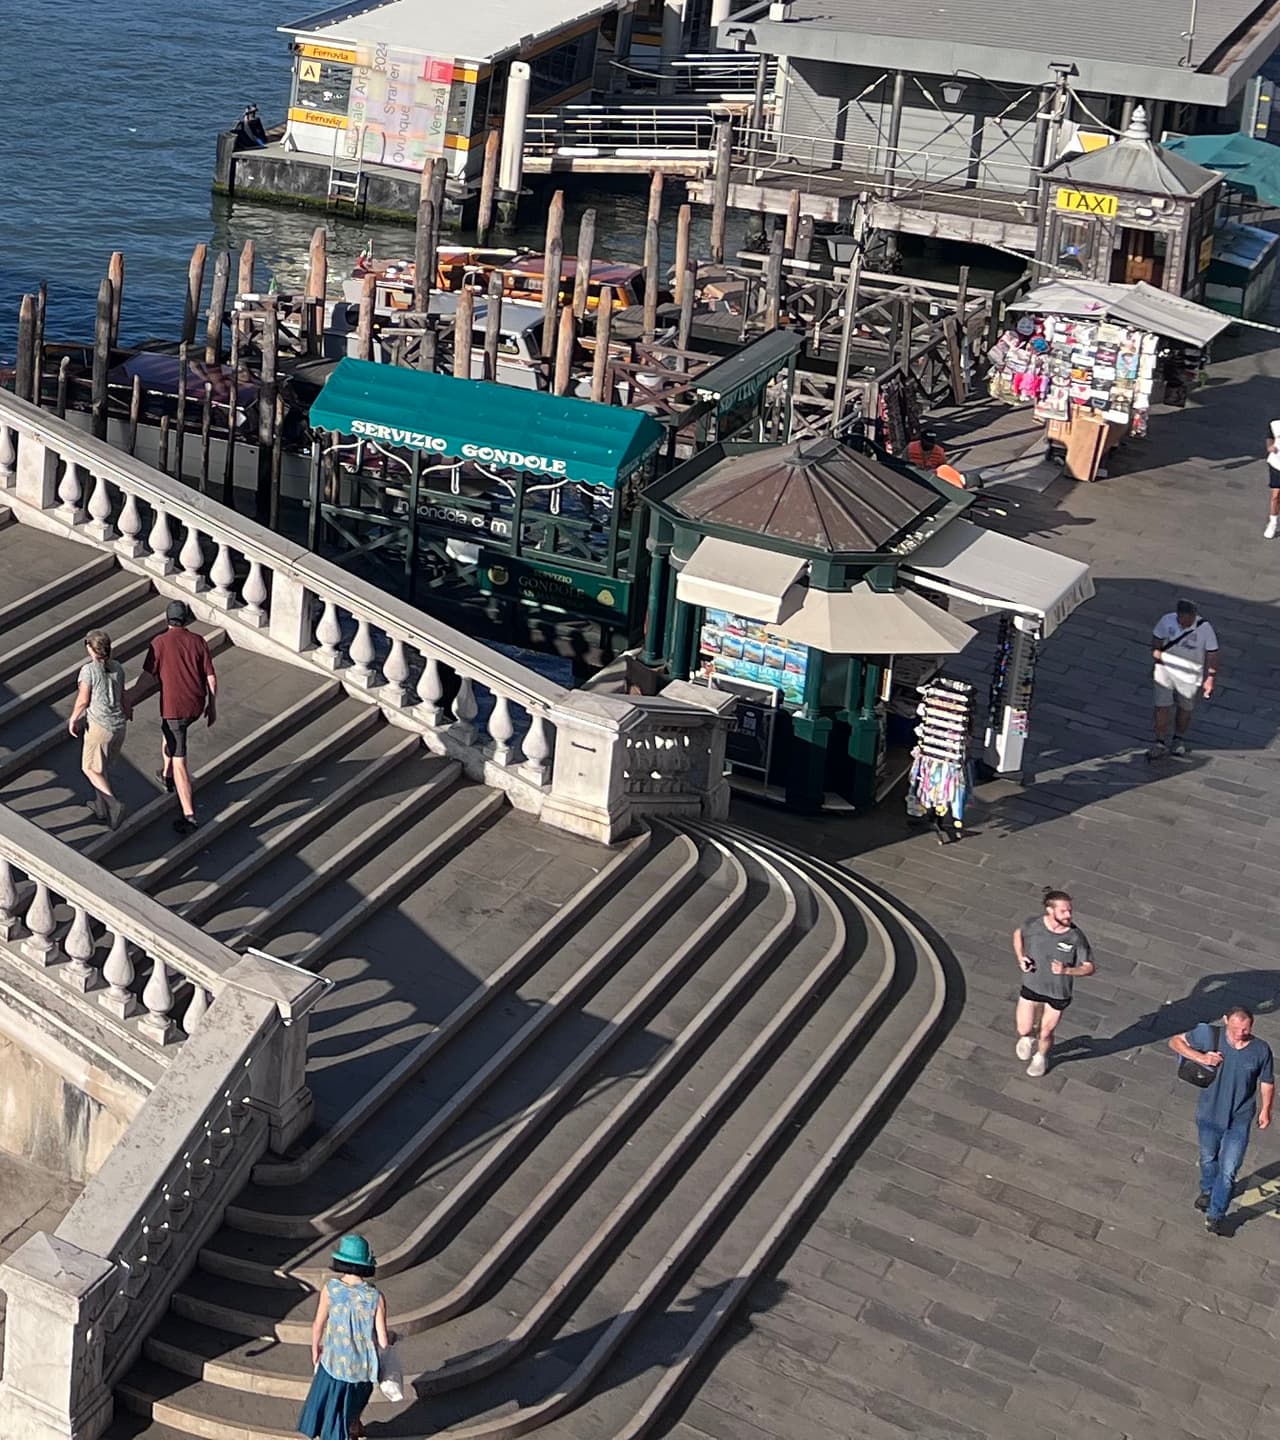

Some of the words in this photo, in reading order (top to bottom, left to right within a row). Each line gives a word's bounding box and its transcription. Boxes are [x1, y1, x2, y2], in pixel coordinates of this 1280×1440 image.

[312, 47, 349, 61] Ferrovia
[374, 42, 388, 72] 2024
[304, 65, 316, 78] A
[305, 112, 342, 126] Ferrovia
[429, 87, 448, 136] Venezia
[393, 105, 413, 163] Ovunque
[1062, 191, 1113, 214] TAXI
[351, 420, 447, 451] SERVIZIO
[461, 443, 567, 475] GONDOLE
